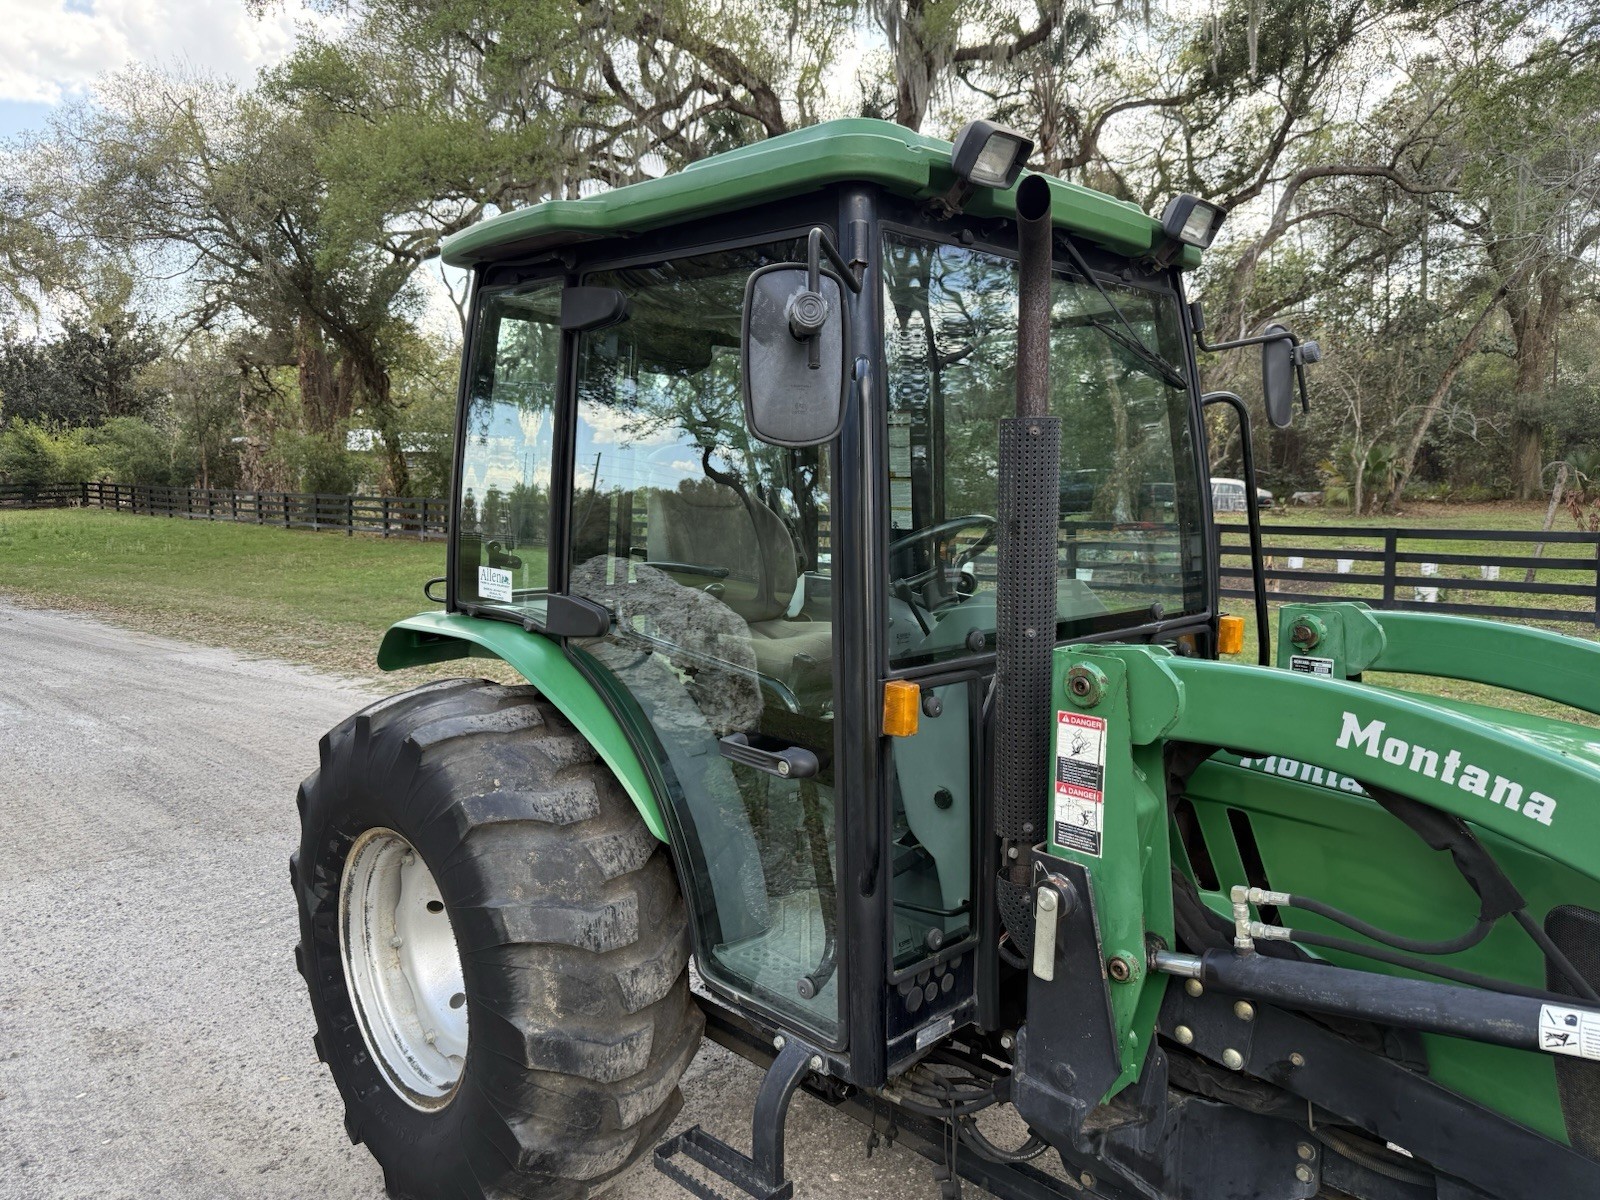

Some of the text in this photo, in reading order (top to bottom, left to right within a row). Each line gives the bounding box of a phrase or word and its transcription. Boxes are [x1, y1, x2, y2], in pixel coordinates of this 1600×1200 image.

[480, 568, 501, 583] Allen
[1070, 716, 1102, 729] DANGER
[1239, 755, 1368, 796] Mona
[1335, 711, 1557, 827] Montana
